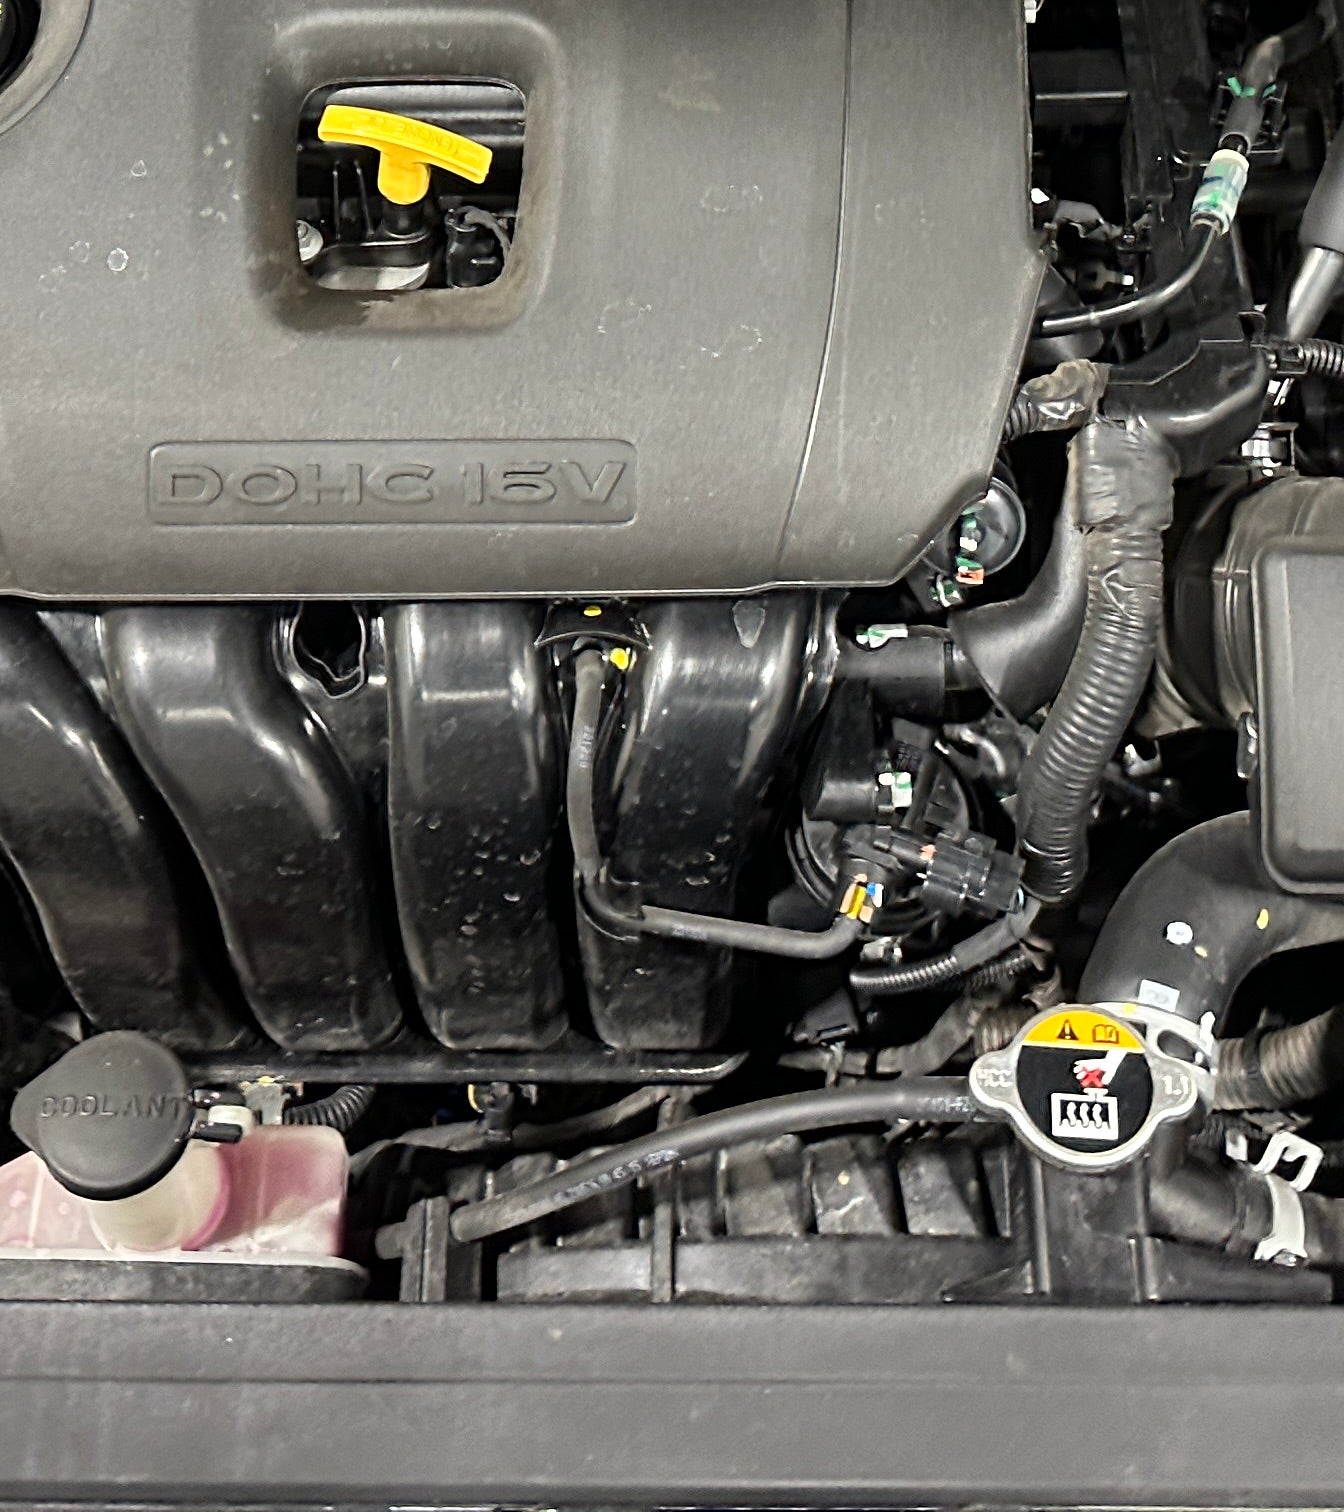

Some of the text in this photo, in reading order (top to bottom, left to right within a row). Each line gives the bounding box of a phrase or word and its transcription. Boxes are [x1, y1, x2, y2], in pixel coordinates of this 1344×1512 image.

[158, 460, 627, 507] DOHC 16V
[1162, 1073, 1189, 1095] 1.1
[40, 1093, 187, 1121] COOLANT
